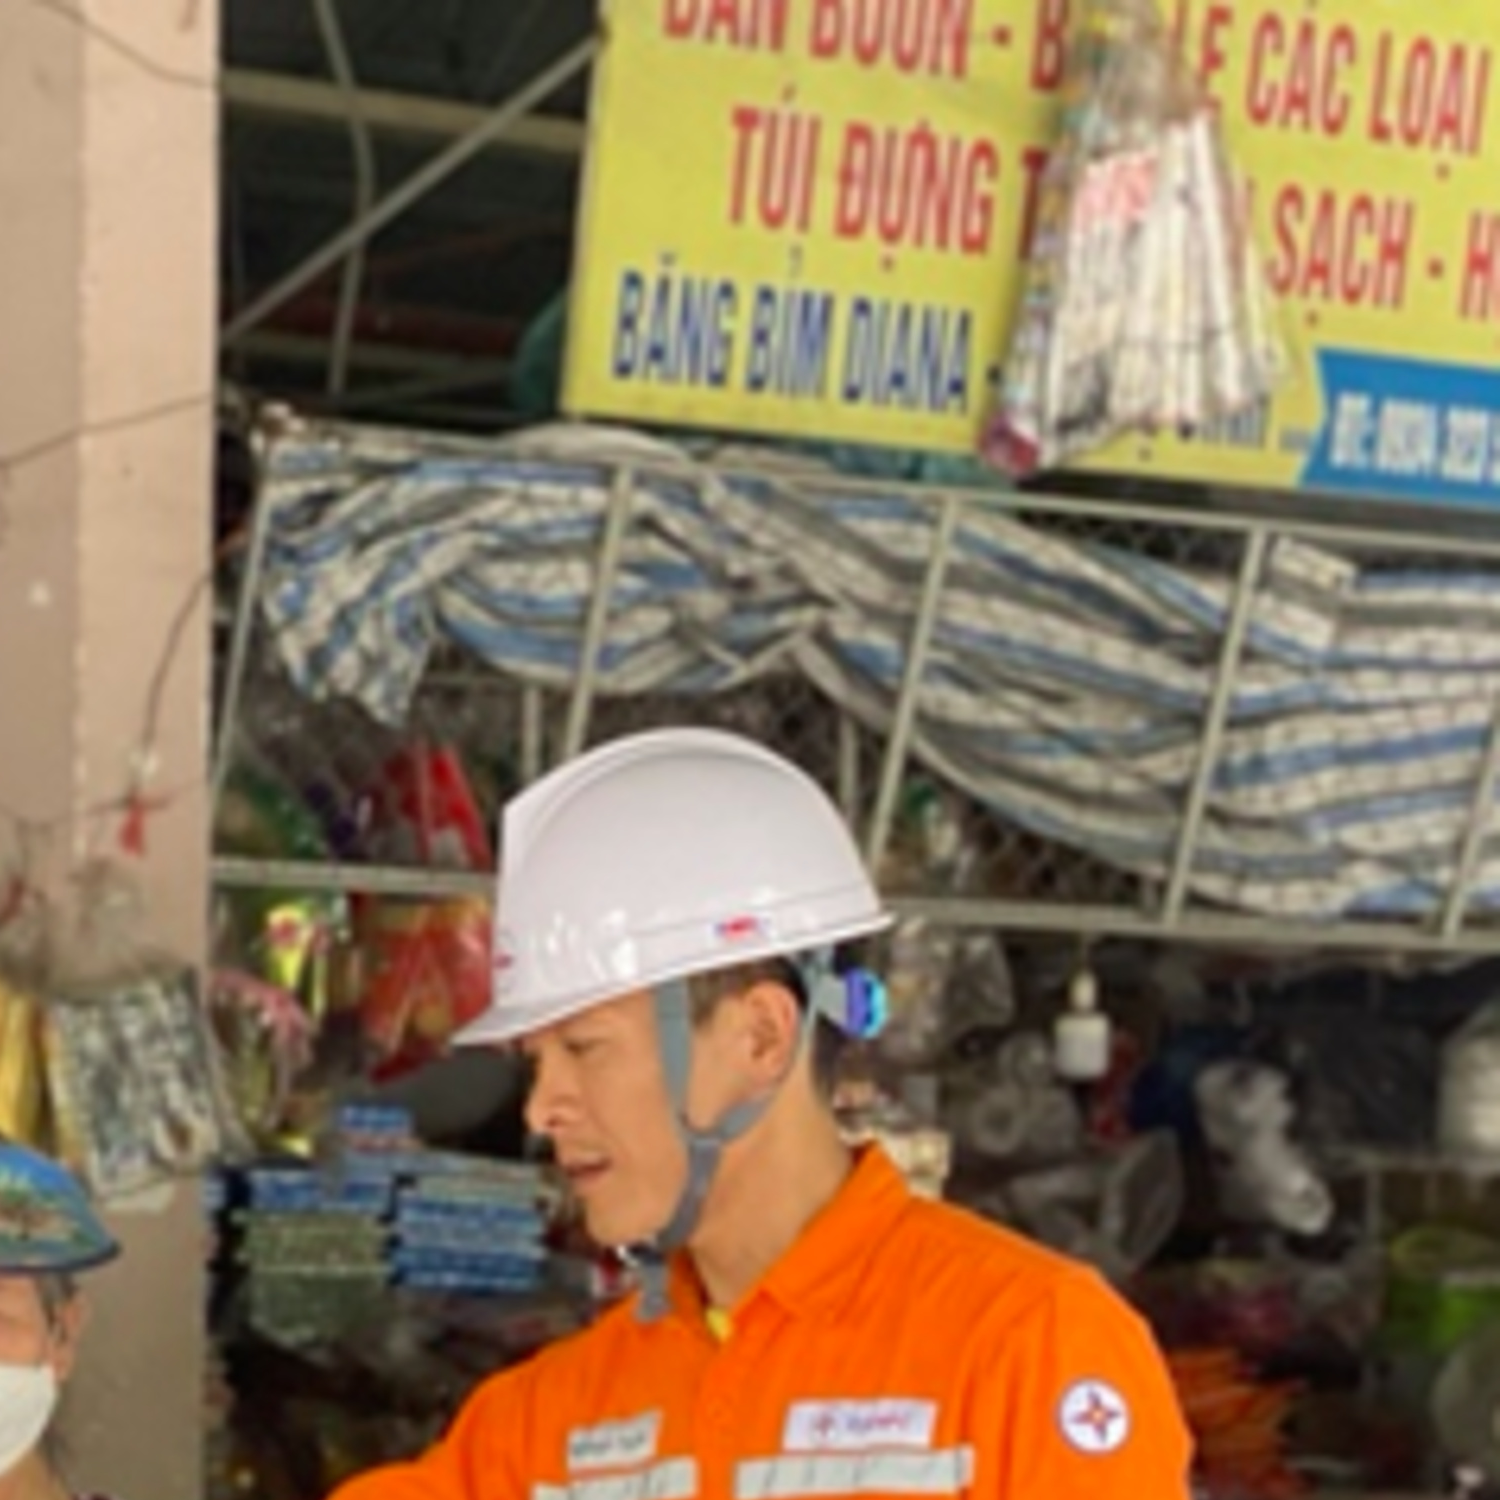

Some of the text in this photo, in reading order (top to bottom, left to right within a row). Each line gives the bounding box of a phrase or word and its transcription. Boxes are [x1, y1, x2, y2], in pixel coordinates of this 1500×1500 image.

[1368, 28, 1492, 182] LOẠI
[729, 85, 820, 233] TÚI
[833, 118, 1000, 272] ĐỰNG
[1265, 183, 1414, 329] SẠCH
[842, 295, 971, 416] DIANA
